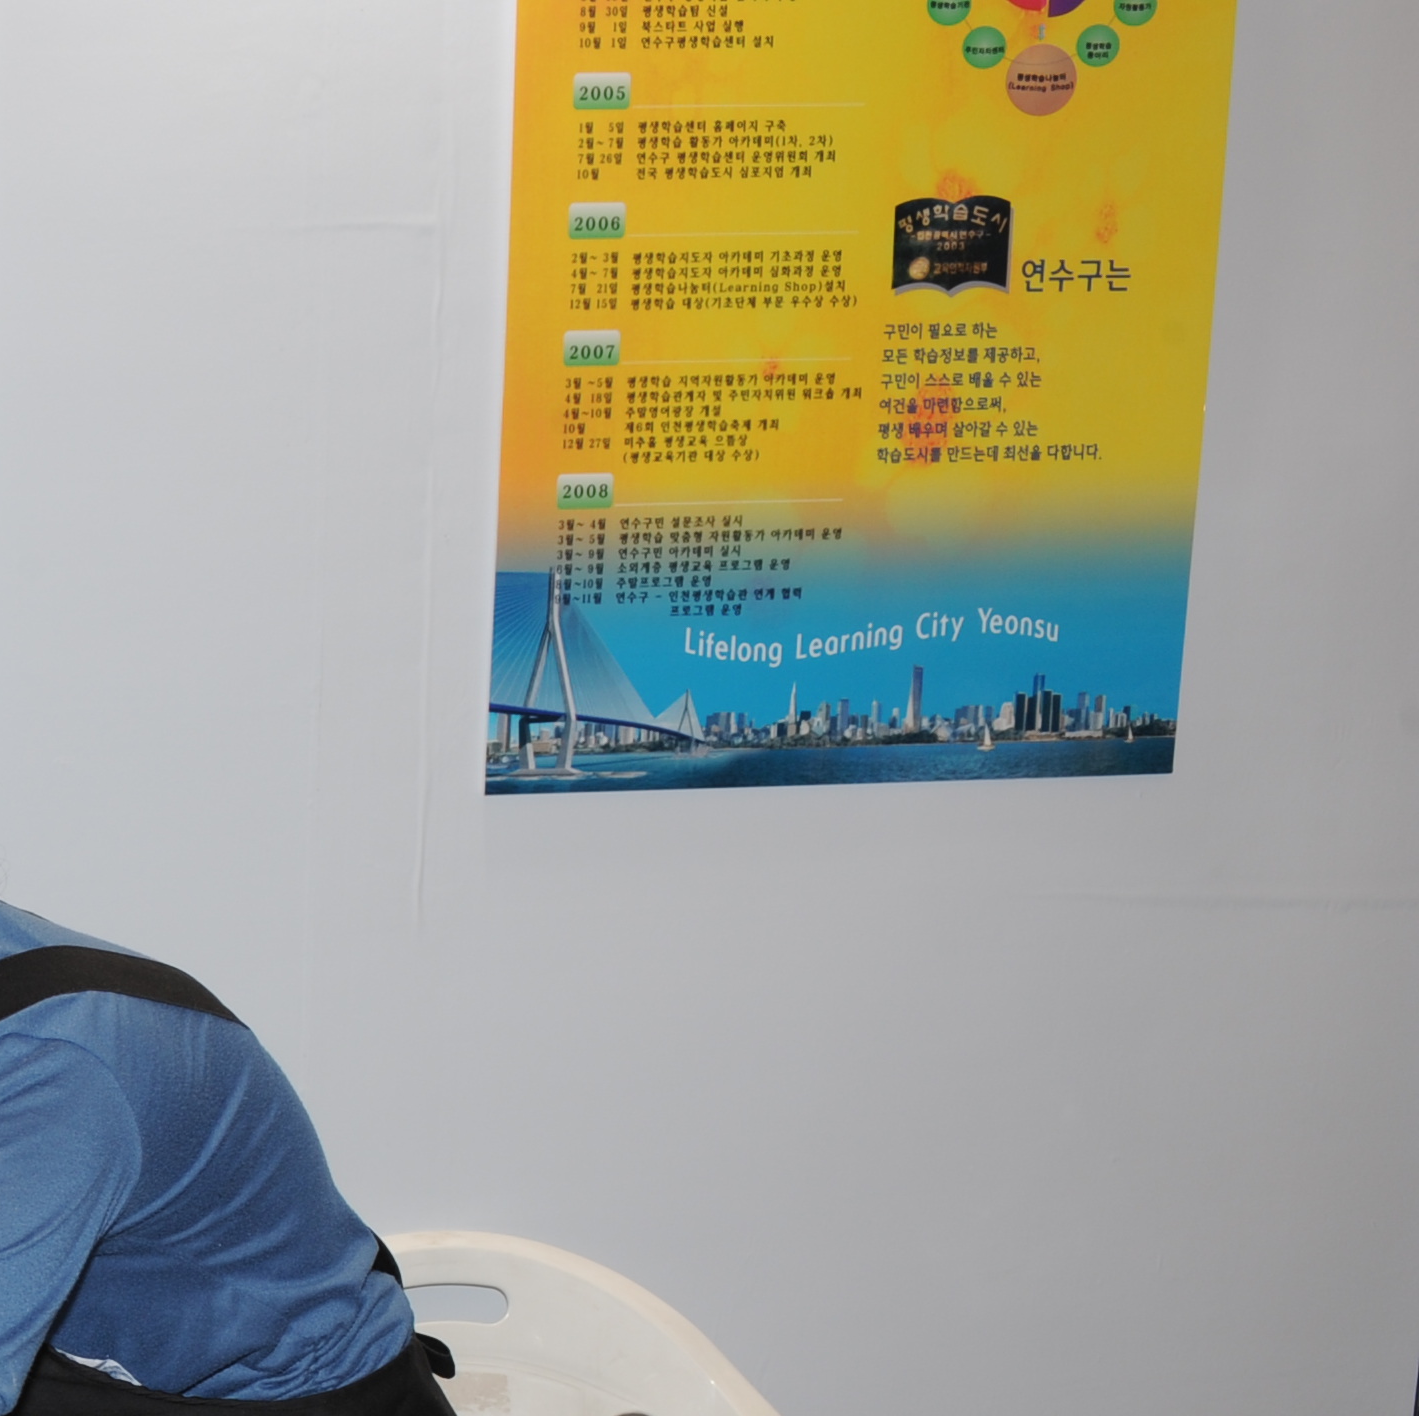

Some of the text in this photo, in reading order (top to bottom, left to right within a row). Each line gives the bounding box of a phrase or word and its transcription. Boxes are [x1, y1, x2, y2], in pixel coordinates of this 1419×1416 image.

[580, 4, 727, 18] 8월 30일 평생학습팀 신설
[580, 35, 773, 49] 10월 1일 연수구평생학습센터 설치
[579, 85, 625, 101] 2005
[574, 216, 620, 231] 2006
[897, 203, 1008, 233] 평생학습도시
[1021, 258, 1131, 292] 연수구는
[883, 321, 997, 340] 구민이 필요로 하는
[569, 344, 614, 360] 2007
[881, 346, 1039, 364] 모든 학습정보를 제공하고,
[880, 371, 1041, 389] 구민이 스스로 배울 수 있는
[879, 395, 1006, 414] 여건을 마련함으로써,
[878, 420, 1038, 439] 평생 배우며 살아갈 수 있는
[877, 443, 1101, 464] 학습도시를 만드는데 최선을 다합니다.
[563, 483, 607, 499] 2008
[683, 607, 1060, 668] Lifelong Learning City Yeonsu
